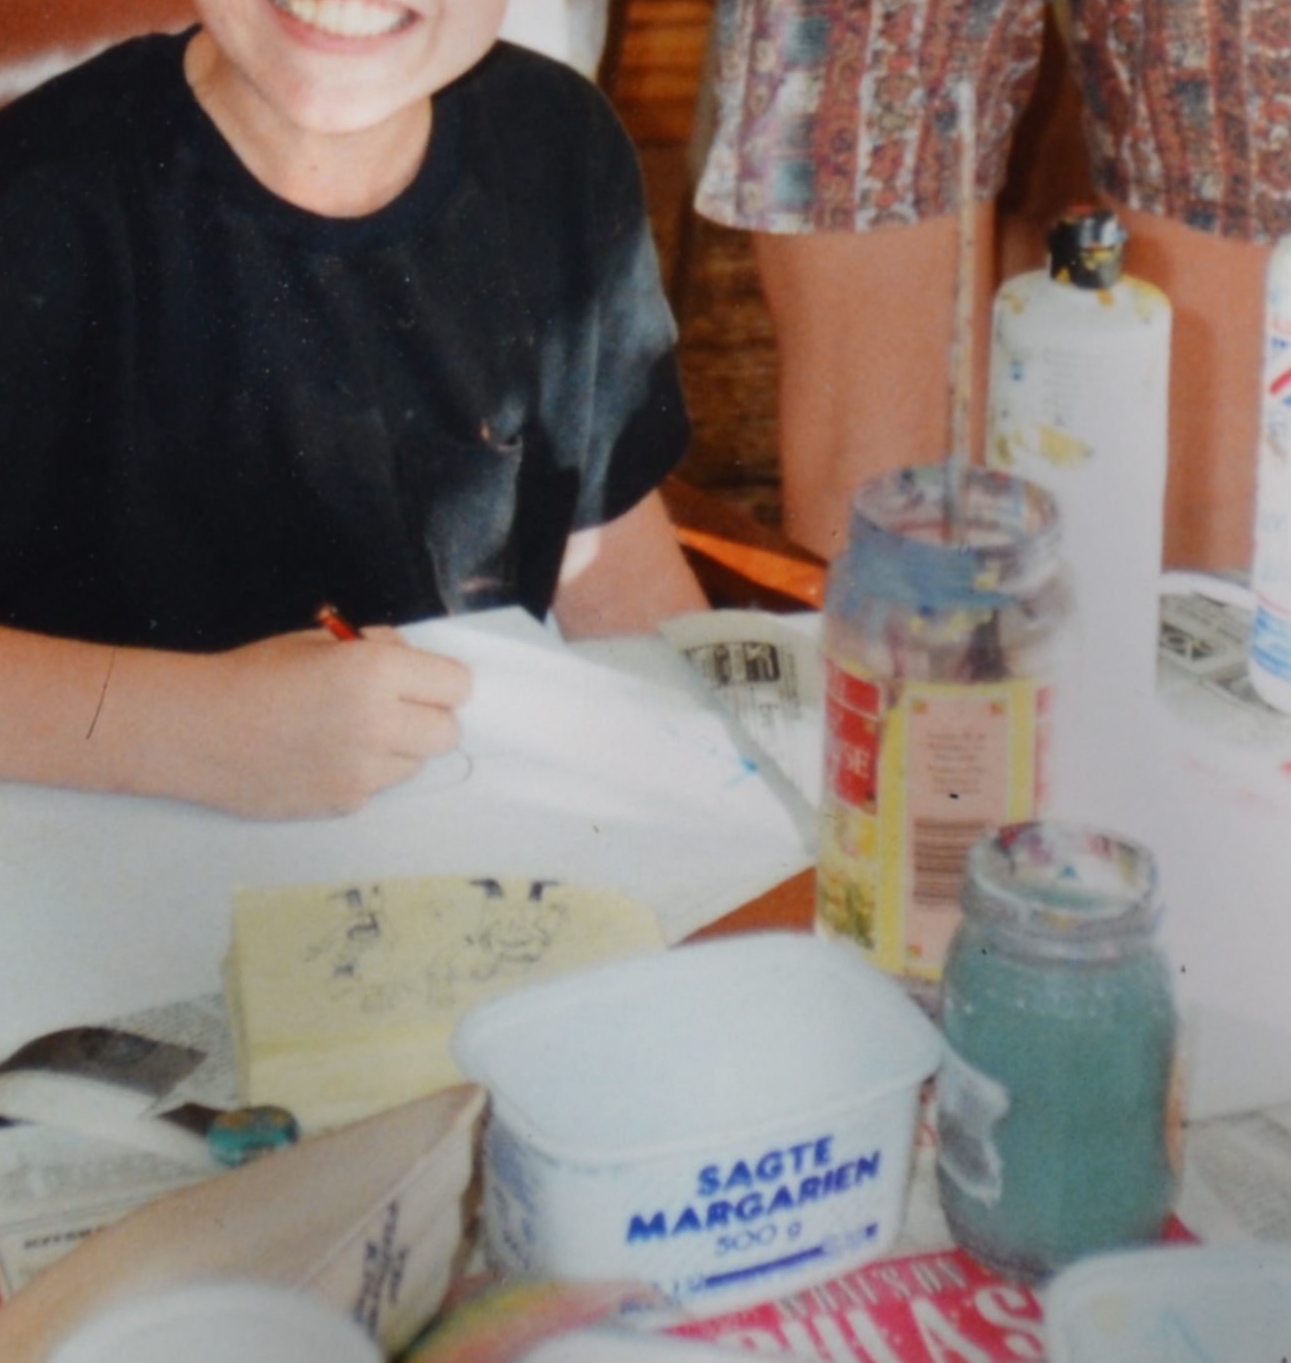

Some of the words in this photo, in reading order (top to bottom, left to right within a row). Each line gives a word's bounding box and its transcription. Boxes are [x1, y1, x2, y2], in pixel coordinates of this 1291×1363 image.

[624, 1148, 884, 1247] MARGARIEN
[696, 1133, 837, 1198] SAGTE
[714, 1223, 777, 1257] 500
